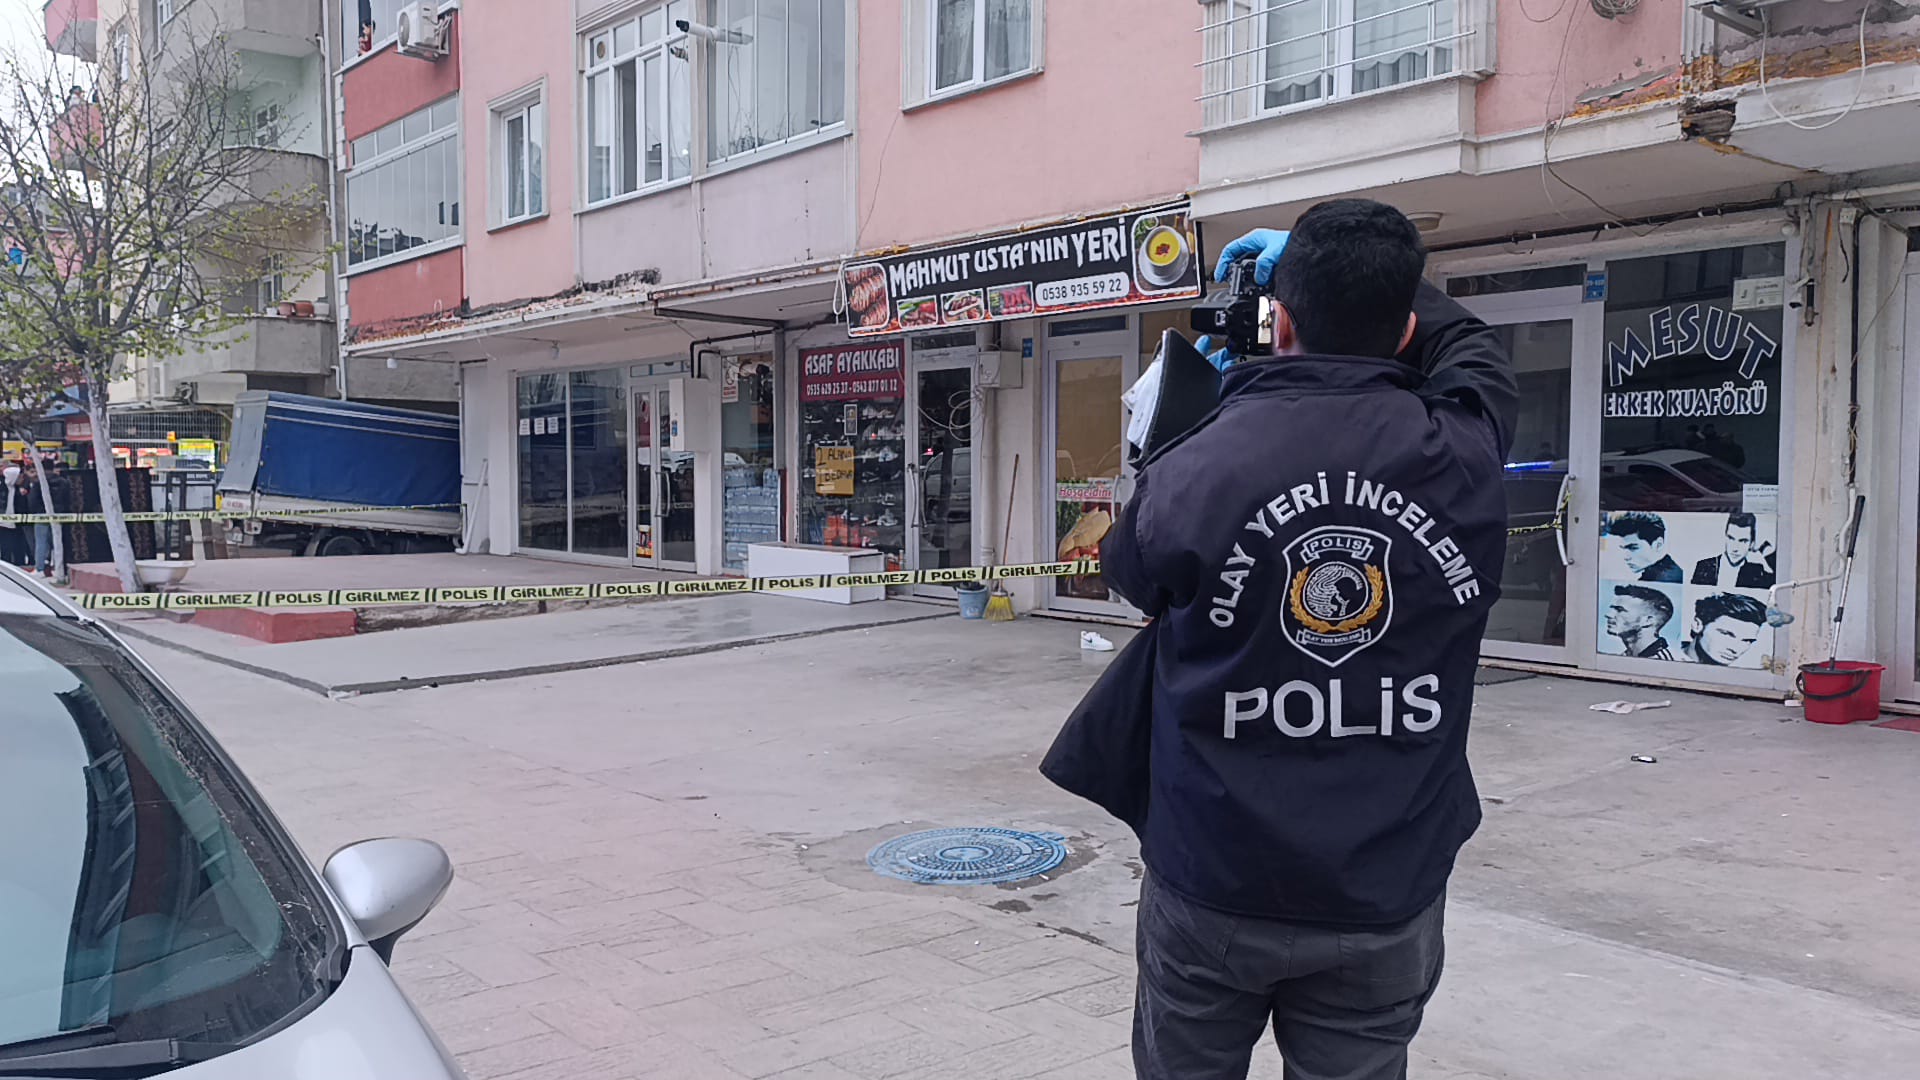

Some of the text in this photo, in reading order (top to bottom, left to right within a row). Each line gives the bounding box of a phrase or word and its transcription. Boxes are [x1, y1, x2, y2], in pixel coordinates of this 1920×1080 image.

[890, 218, 1127, 298] MAHMUT USTA'NIN YERİ
[1042, 278, 1122, 301] 0538 935 59 22
[804, 347, 899, 376] ASAF AYAKKABI
[1608, 303, 1778, 387] MESUT
[1604, 380, 1768, 418] ERKEK KUAFÖRÜ
[1209, 471, 1481, 628] OLAY YERİ İNCELEME
[1223, 673, 1442, 740] POLİS
